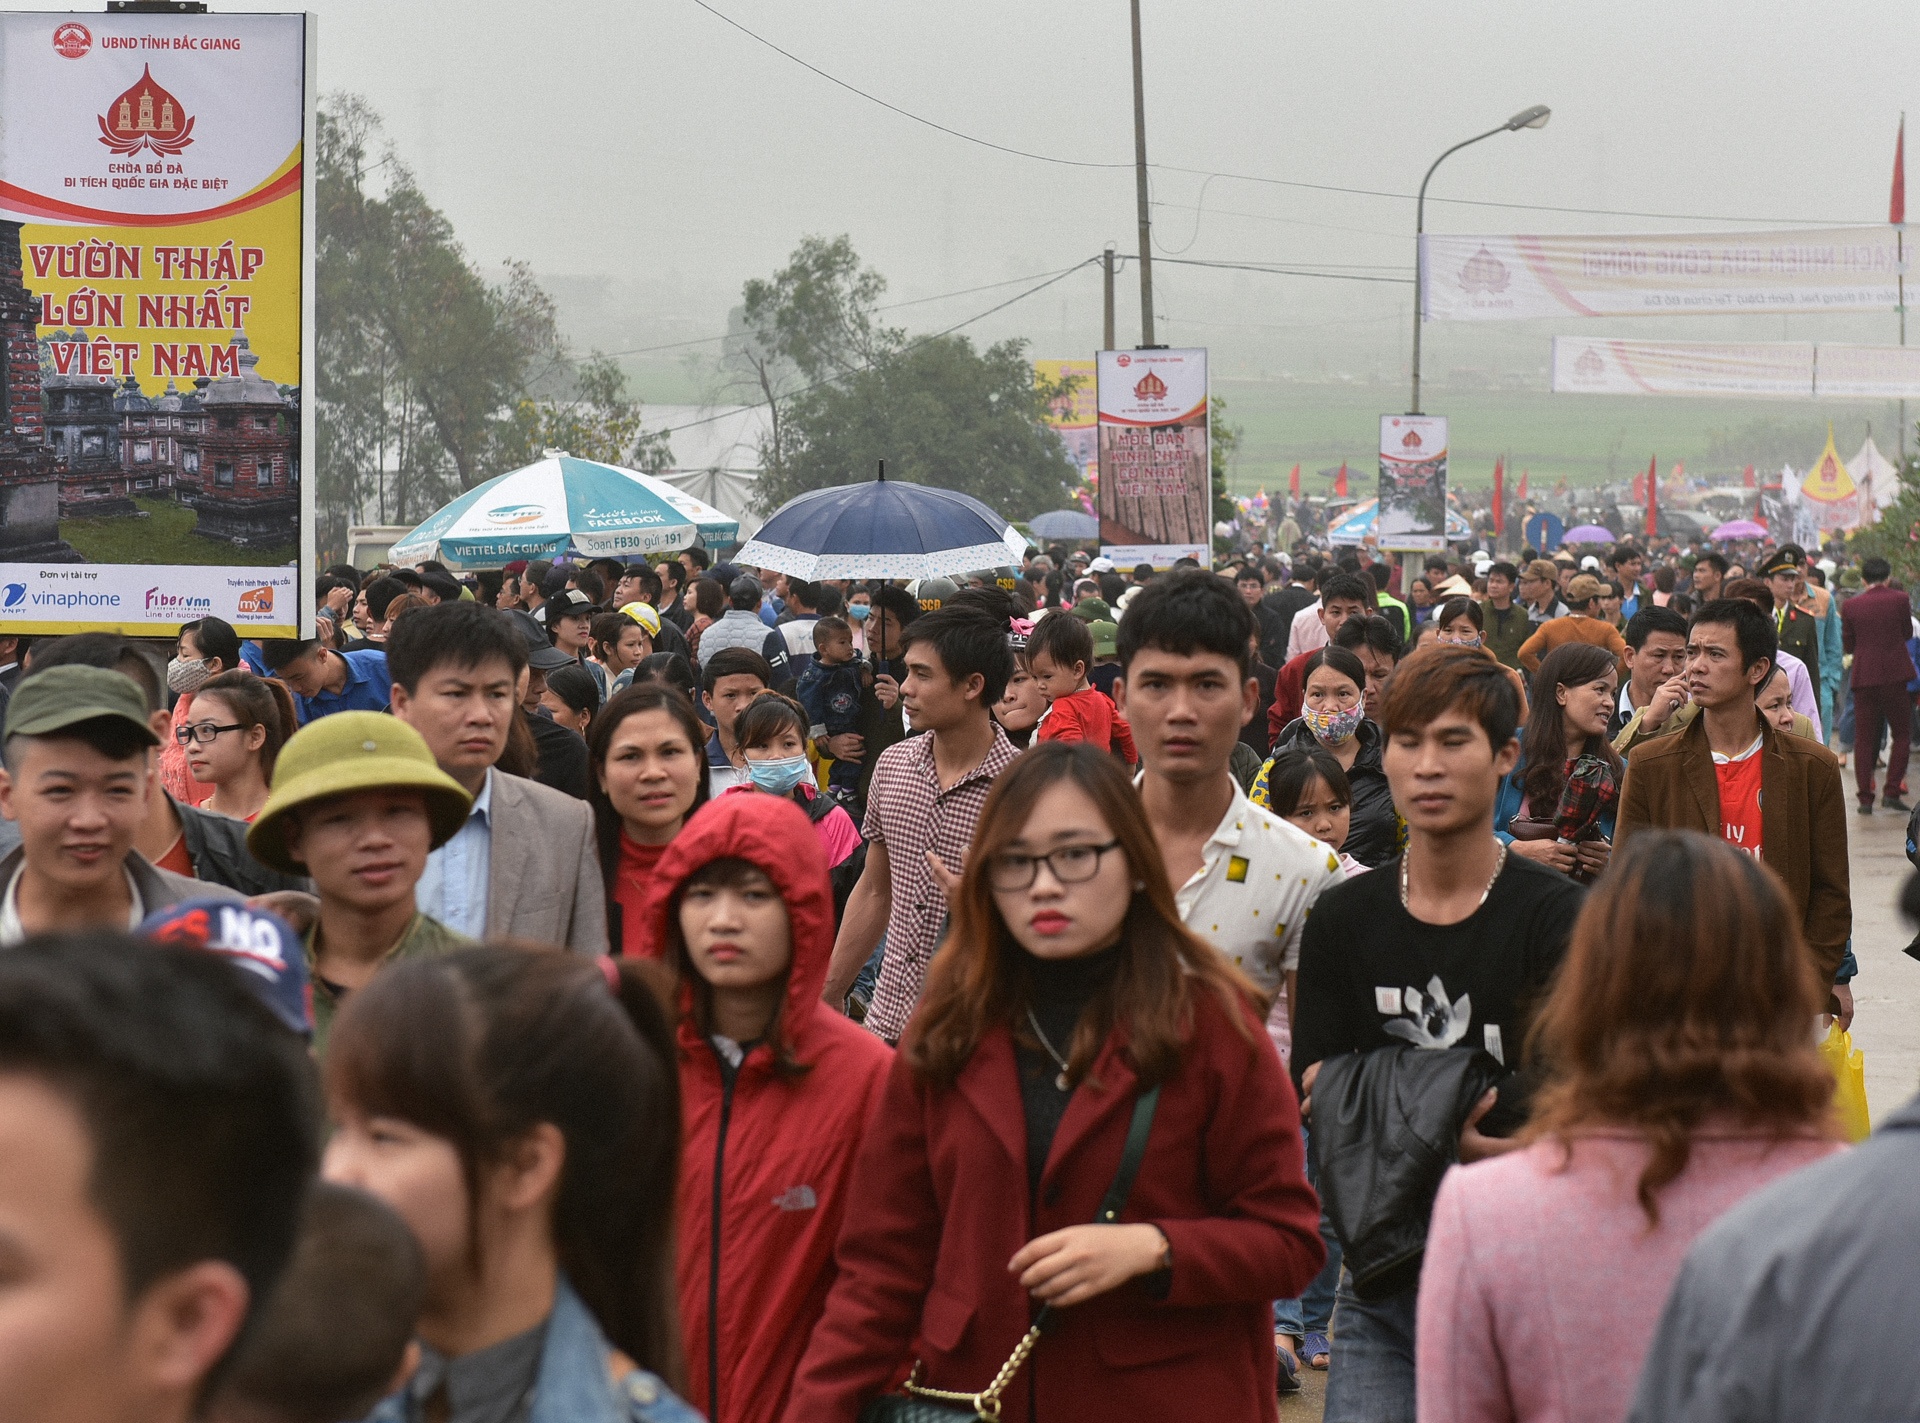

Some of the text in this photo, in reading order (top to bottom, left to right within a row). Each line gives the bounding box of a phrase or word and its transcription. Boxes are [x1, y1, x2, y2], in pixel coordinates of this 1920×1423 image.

[102, 34, 241, 50] UBND TỈNH BẮC GIANG
[108, 159, 183, 174] CHÙA BỔ ĐÀ
[80, 175, 108, 188] TÍCH
[112, 174, 145, 190] QUỐC
[149, 178, 169, 189] GIA
[173, 177, 198, 191] ĐẶC
[202, 177, 228, 192] BIỆT
[27, 238, 264, 281] VƯỜN THÁP
[41, 284, 251, 330] LỚN NHẤT
[48, 335, 242, 385] VIỆT NAM
[1155, 483, 1188, 496] NAM
[487, 510, 546, 518] VIETTEL
[587, 514, 666, 528] FACEBOOK
[454, 545, 496, 557] VIETTEL
[498, 542, 520, 555] BẮC
[521, 542, 557, 554] GIANG
[587, 537, 613, 553] Soạn
[614, 536, 640, 548] FB30
[644, 534, 660, 549] gửi
[665, 533, 681, 545] 191
[39, 570, 98, 581] Đơn vị tài trợ
[31, 589, 121, 609] vinaphone
[239, 598, 272, 612] mytv
